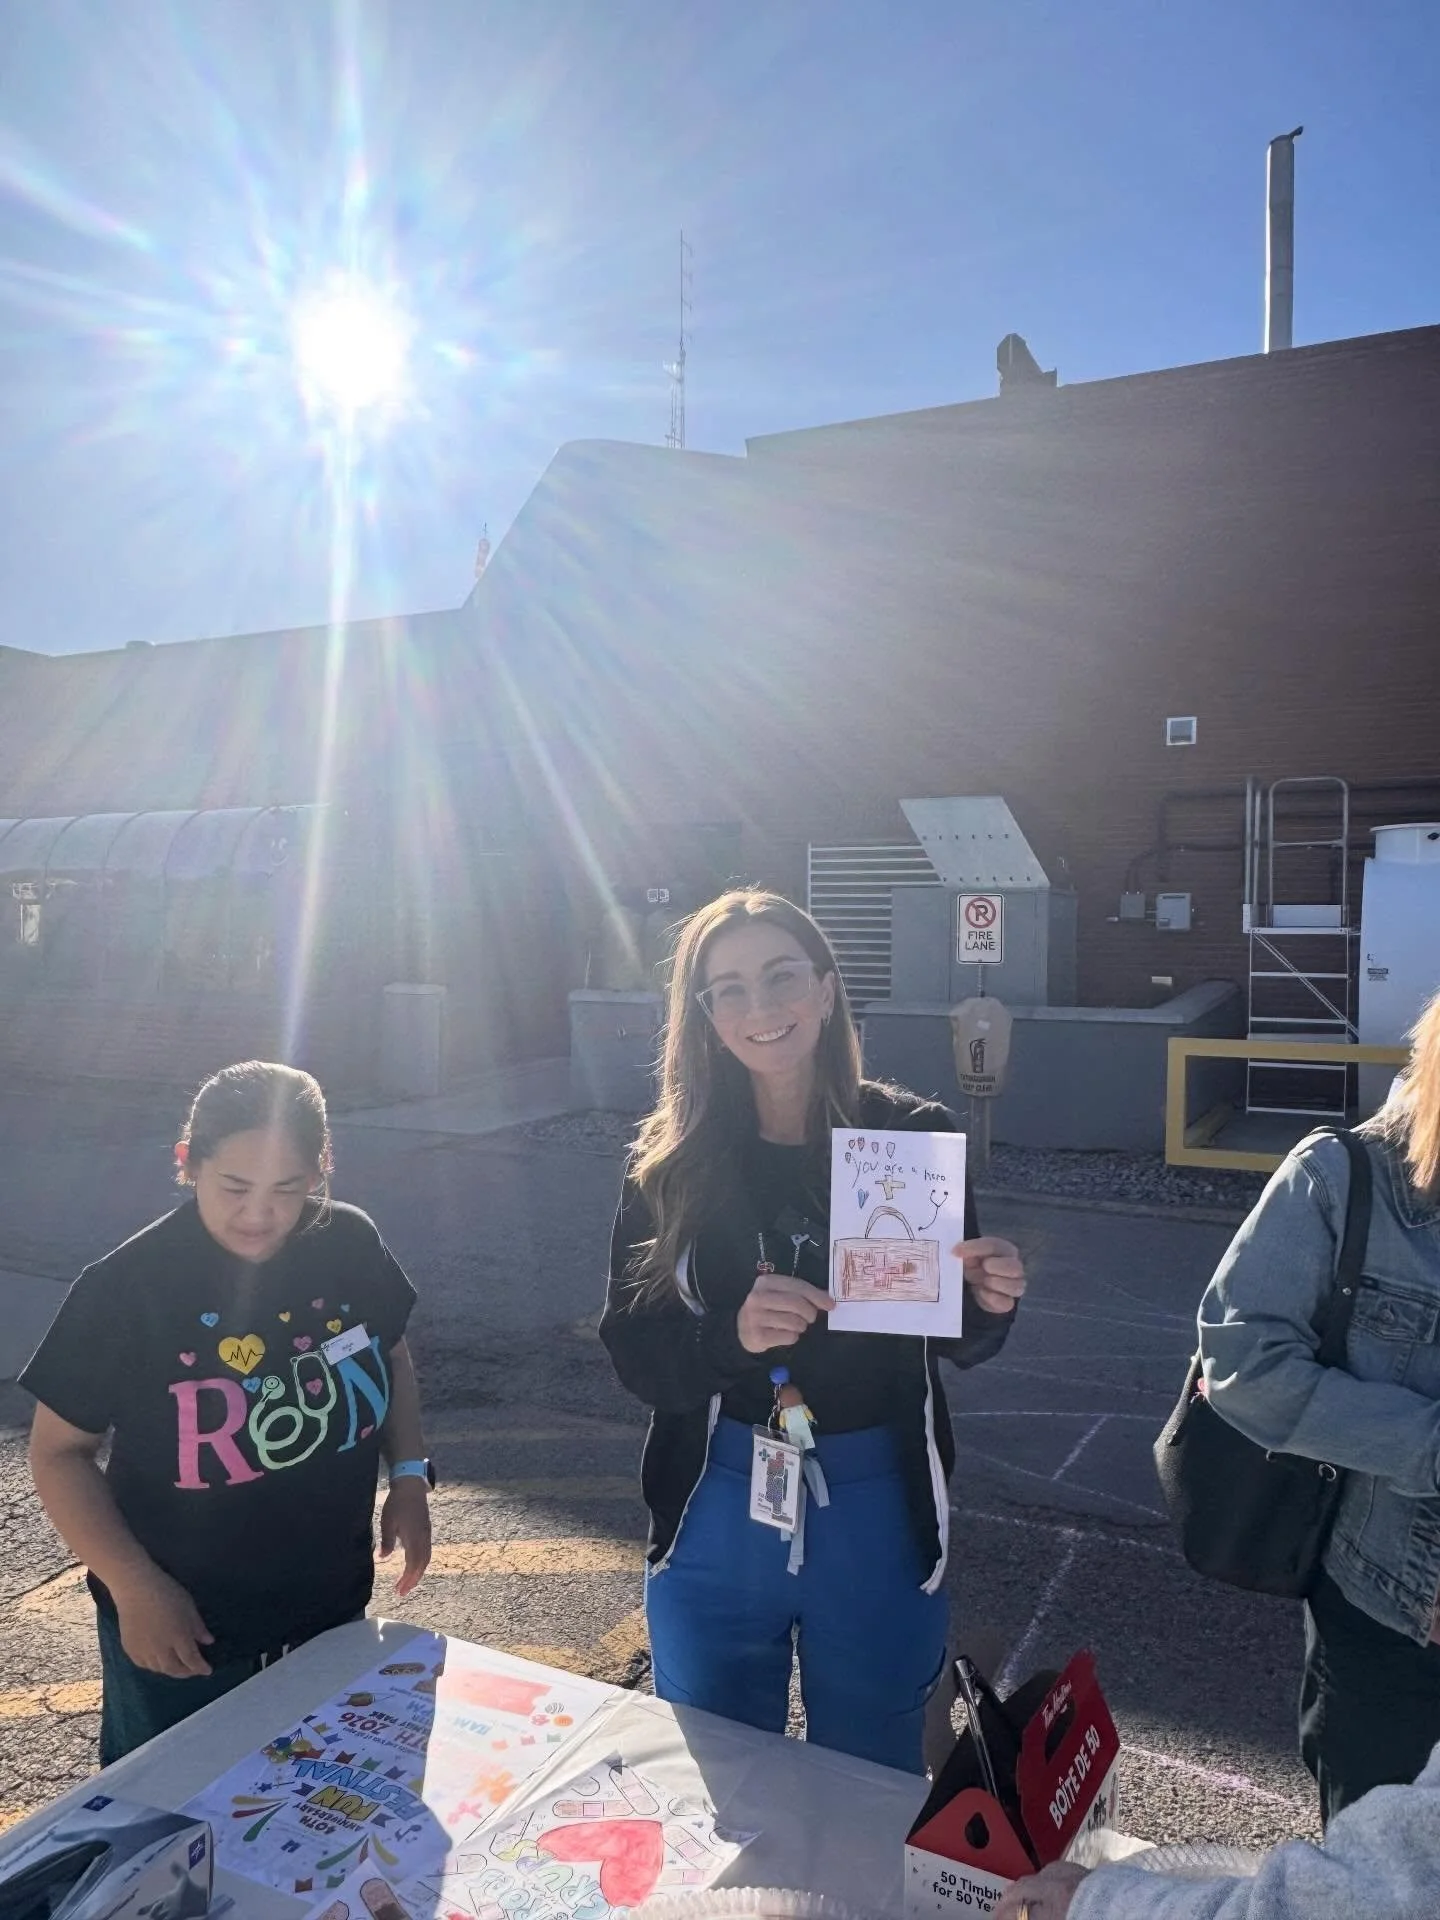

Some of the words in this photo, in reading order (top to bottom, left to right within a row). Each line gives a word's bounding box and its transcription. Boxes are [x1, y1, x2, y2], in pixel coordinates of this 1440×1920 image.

[964, 941, 997, 951] LANE
[967, 930, 994, 941] FIRE
[884, 1163, 904, 1175] are
[924, 1169, 946, 1182] hero
[337, 1711, 390, 1737] 2026
[393, 1728, 429, 1753] TH
[290, 1759, 428, 1821] FESTIVAL
[1048, 1766, 1081, 1830] BOÎTE
[1073, 1744, 1091, 1780] DE
[1084, 1724, 1101, 1757] 50
[308, 1785, 381, 1822] FUN
[292, 1802, 364, 1832] ANNIVERSARY
[941, 1871, 957, 1886] 50
[932, 1881, 953, 1898] for
[956, 1890, 972, 1905] 50
[976, 1897, 995, 1912] Ye
